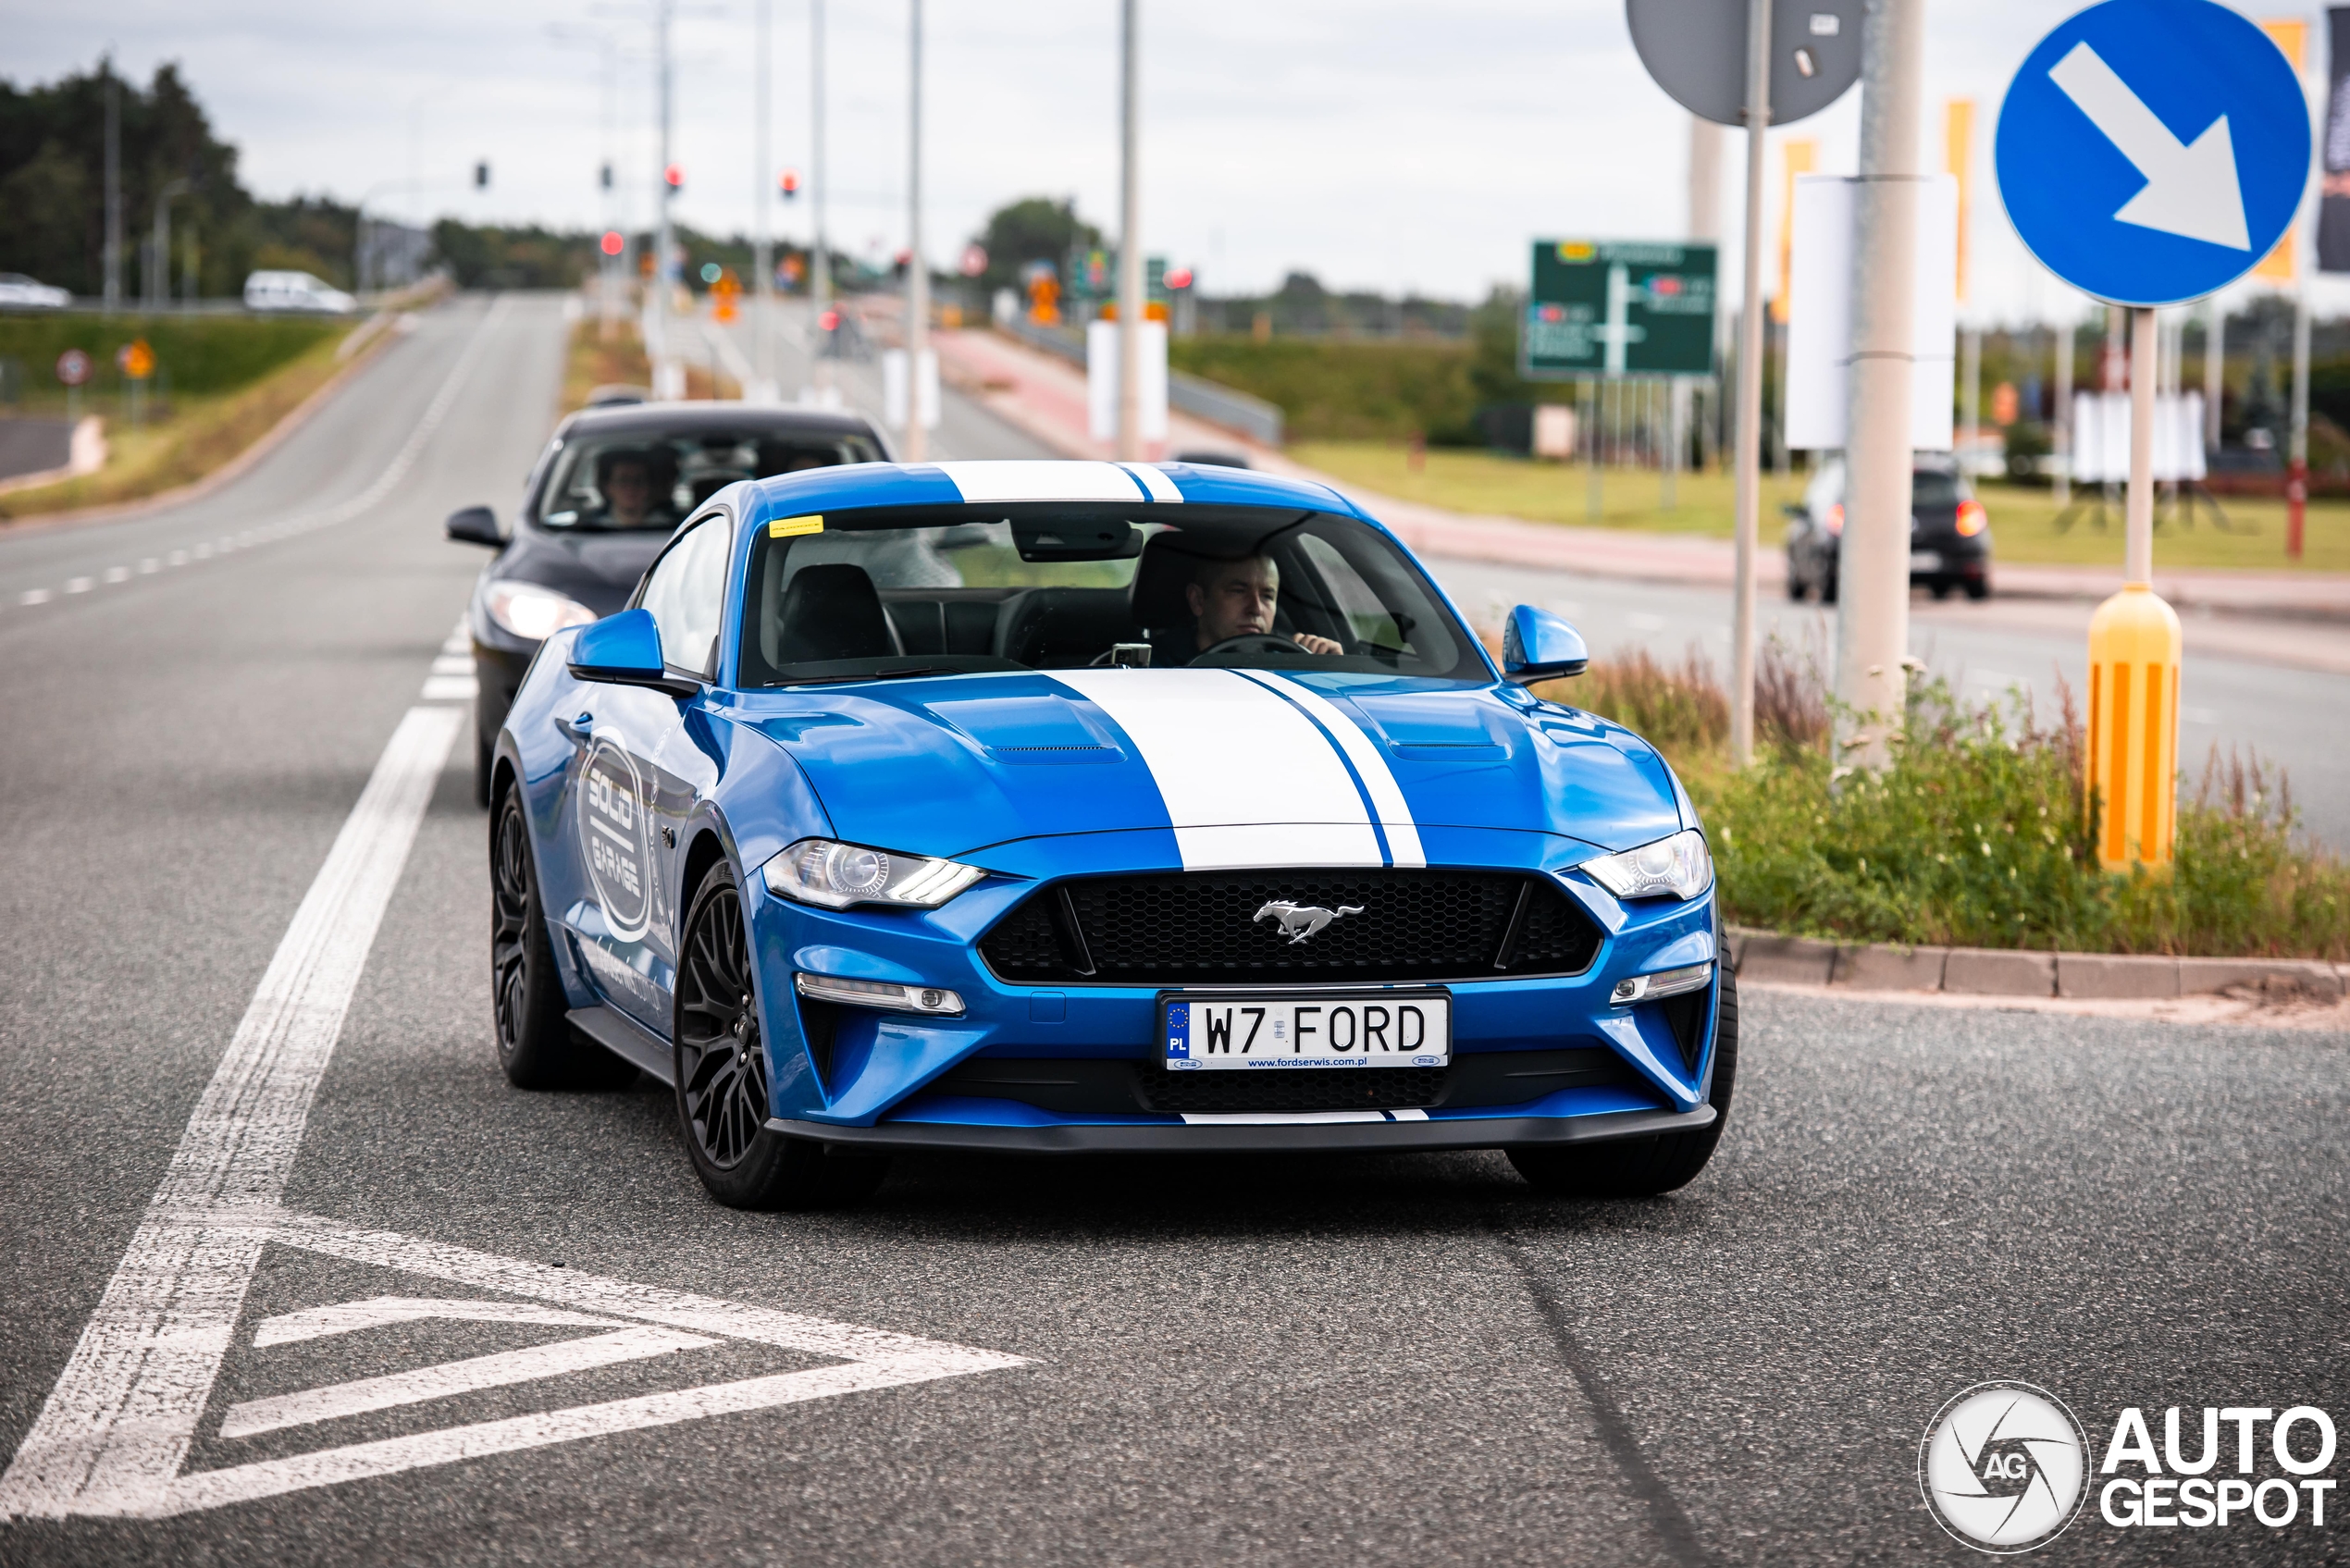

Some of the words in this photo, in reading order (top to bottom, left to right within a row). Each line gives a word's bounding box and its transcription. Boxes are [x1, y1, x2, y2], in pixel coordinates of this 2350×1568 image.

[591, 835, 641, 898] GARAGE
[1169, 1038, 1187, 1051] PL
[1206, 1007, 1266, 1054] W7
[1293, 1006, 1425, 1054] FORD
[1248, 1056, 1367, 1068] www.fordserwis.com.pl
